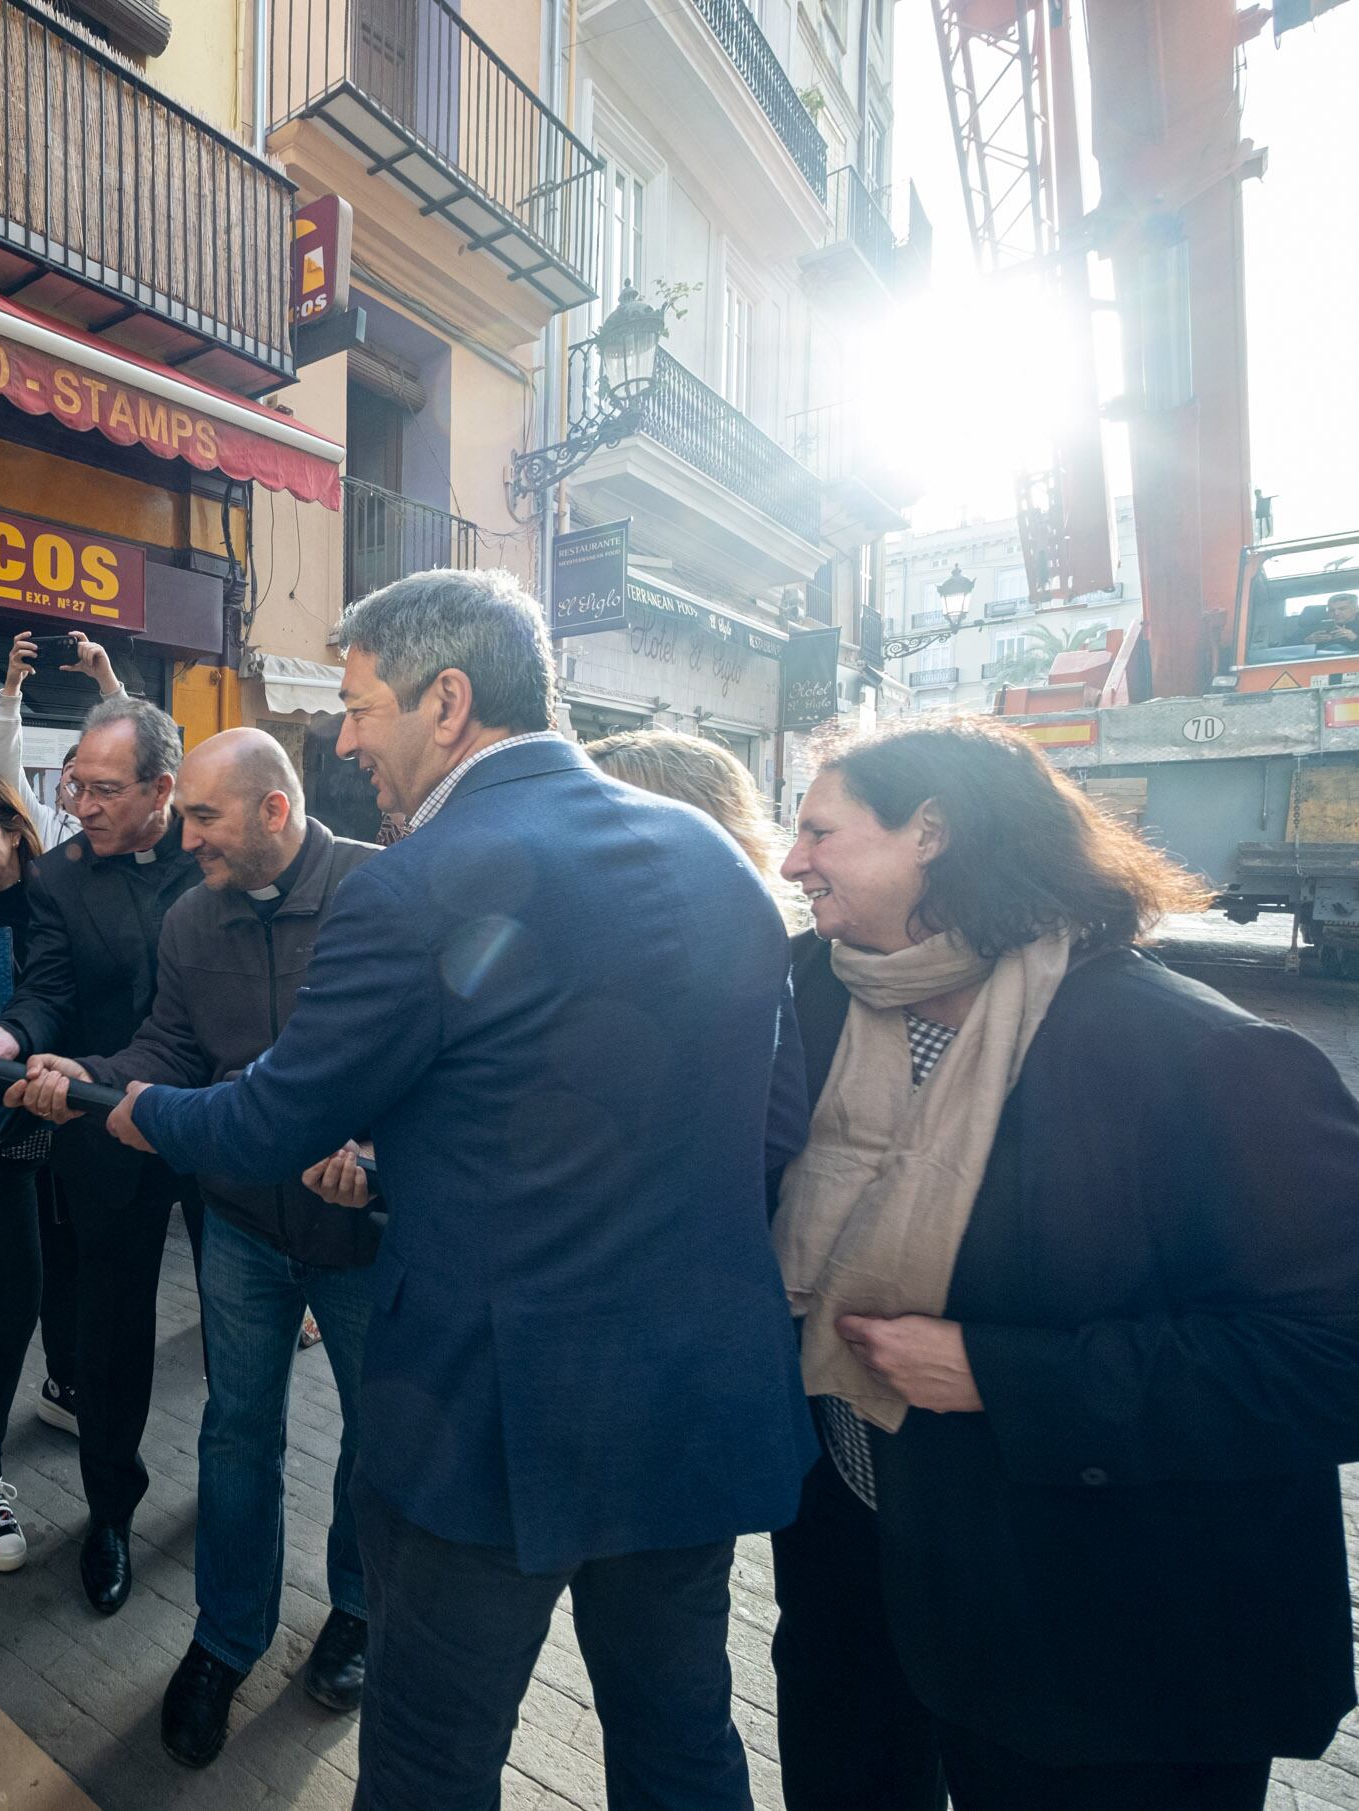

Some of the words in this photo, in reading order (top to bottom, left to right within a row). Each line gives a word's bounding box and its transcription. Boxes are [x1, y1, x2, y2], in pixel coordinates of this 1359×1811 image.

[53, 368, 218, 462] STAMPS
[558, 536, 621, 558] RESTAURANTE
[25, 591, 51, 606] EXP.
[72, 600, 85, 612] 27
[1191, 718, 1216, 740] 70
